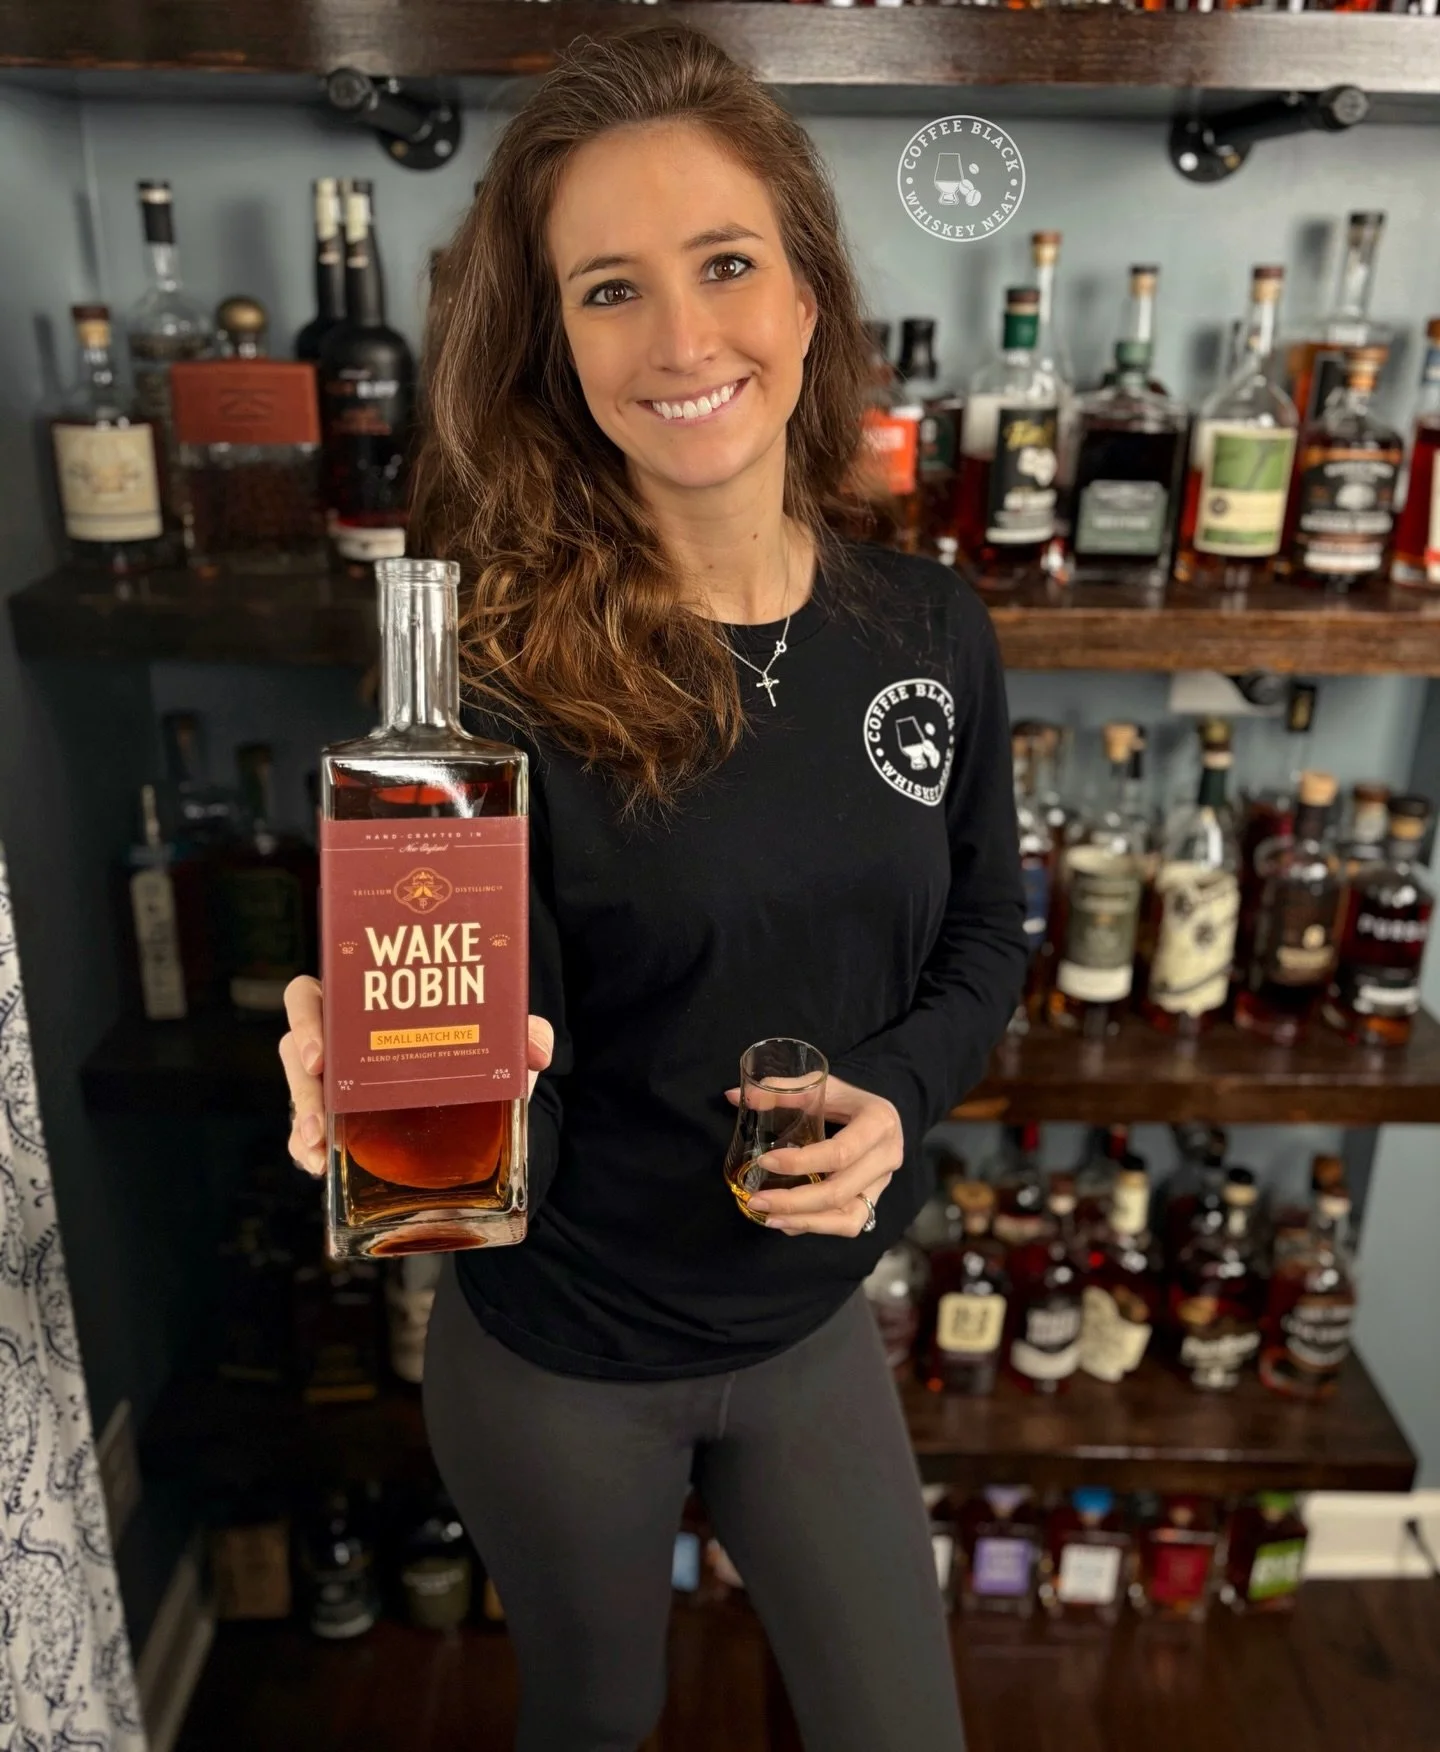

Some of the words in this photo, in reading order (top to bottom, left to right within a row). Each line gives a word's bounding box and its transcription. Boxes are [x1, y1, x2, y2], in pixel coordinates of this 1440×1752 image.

[868, 686, 910, 743] COFFEE
[365, 832, 461, 840] HAND-CRAFTED
[352, 889, 392, 897] TRILLIUM
[455, 885, 496, 893] DISTILLING
[364, 922, 482, 967] WAKE
[363, 965, 485, 1011] ROBIN
[376, 1034, 412, 1046] SMALL
[415, 1031, 451, 1043] BATCH
[454, 1029, 473, 1040] RYE
[367, 1055, 391, 1063] BLEND
[392, 1053, 400, 1062] of
[401, 1052, 437, 1061] STRAIGHT
[438, 1050, 451, 1058] RYE
[453, 1048, 490, 1057] WHISKEYS
